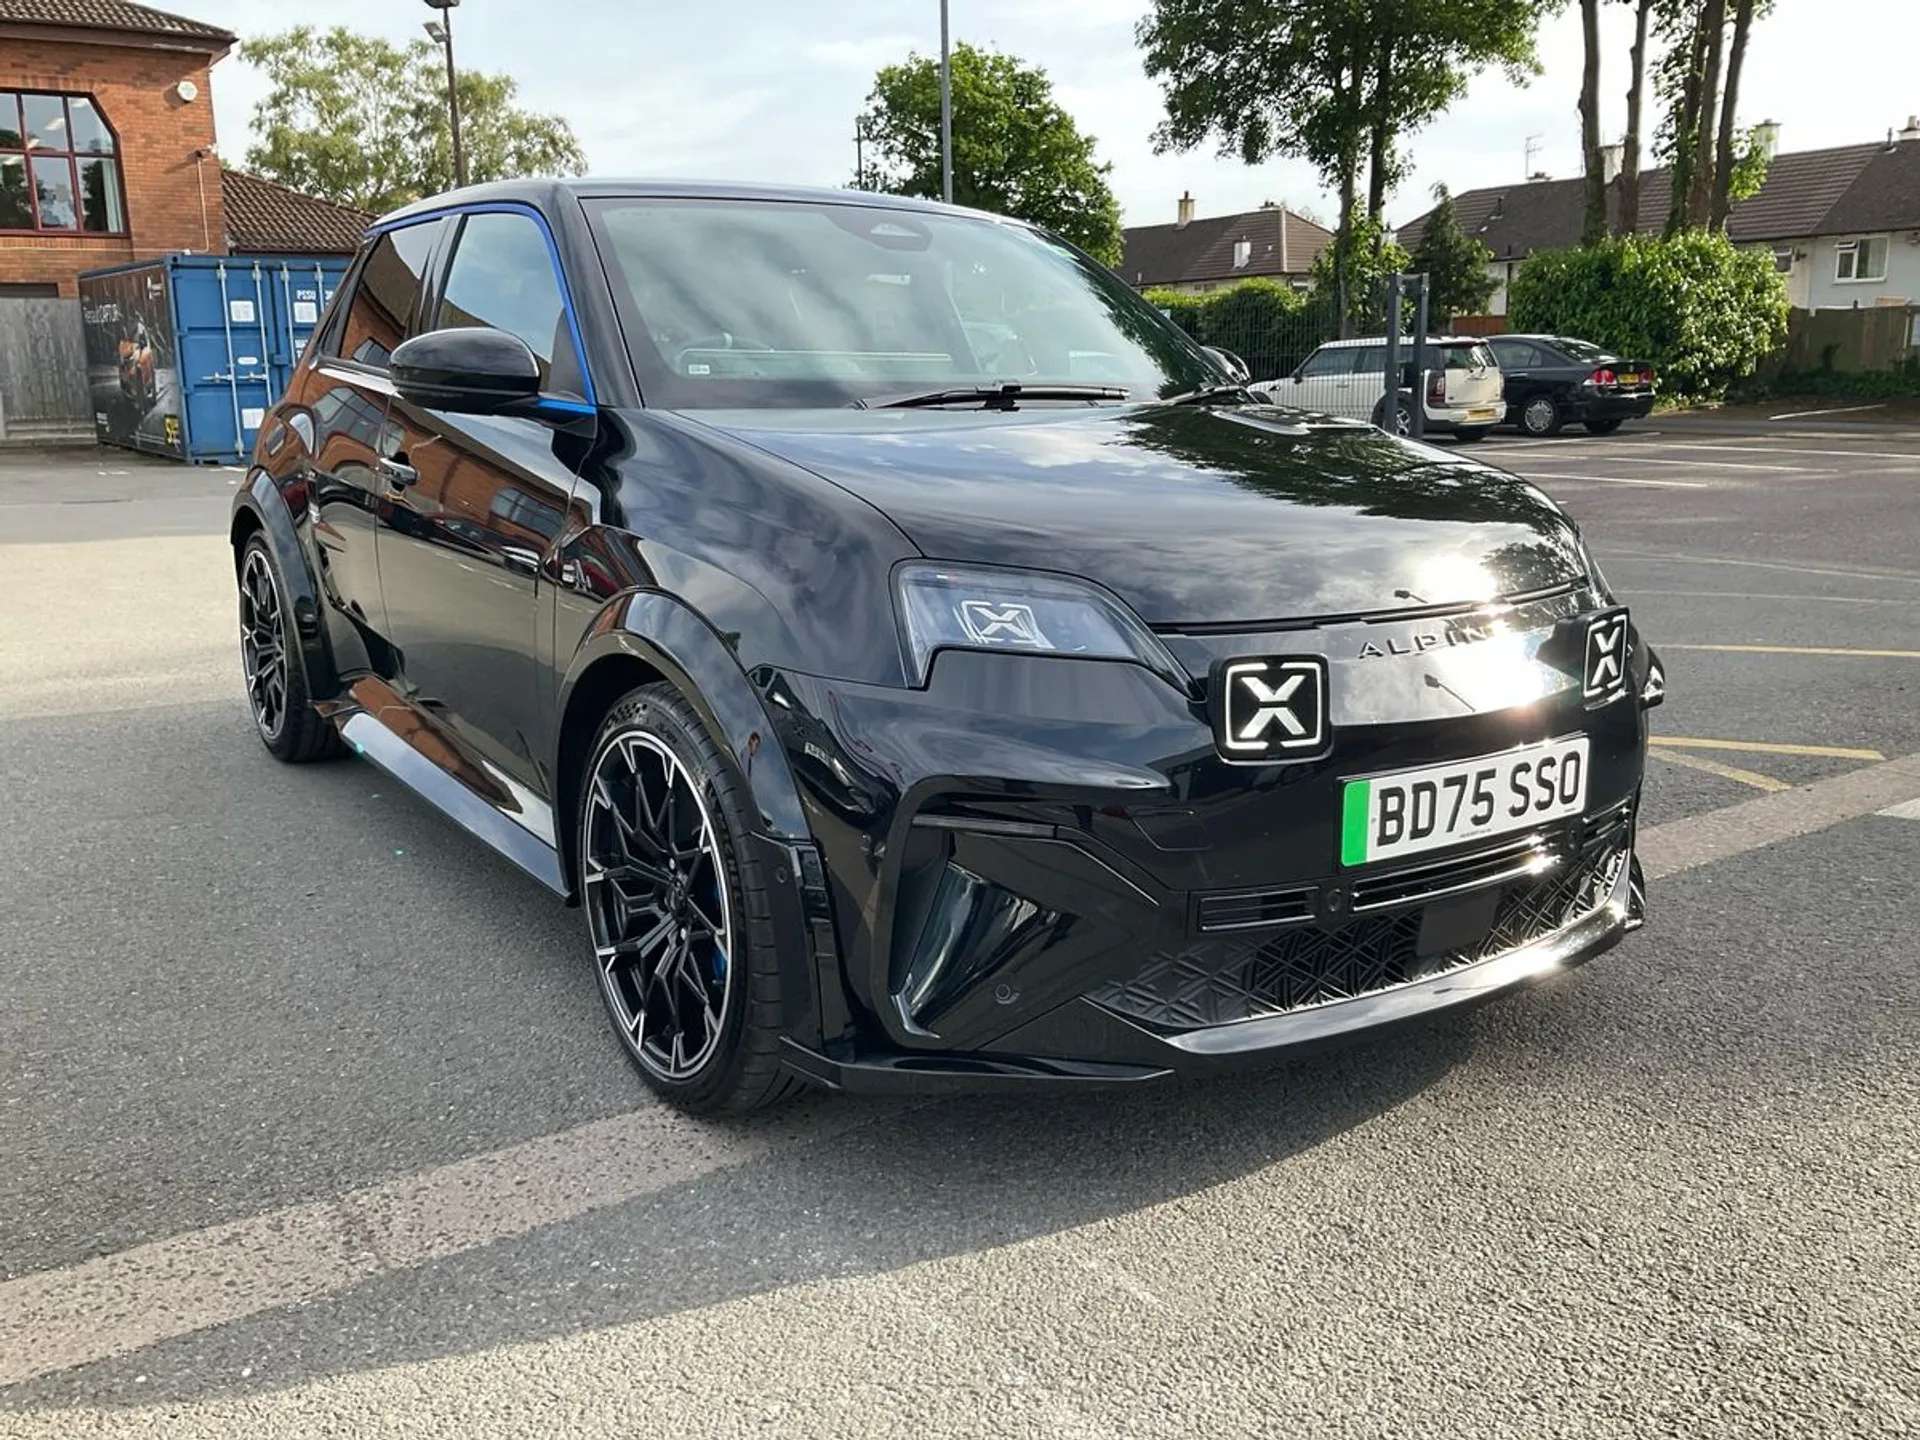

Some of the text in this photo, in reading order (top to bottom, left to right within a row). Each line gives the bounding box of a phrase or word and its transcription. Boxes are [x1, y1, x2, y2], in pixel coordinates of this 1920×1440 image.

[1358, 624, 1496, 660] ALPIN
[1376, 750, 1581, 847] BD75 SSO
